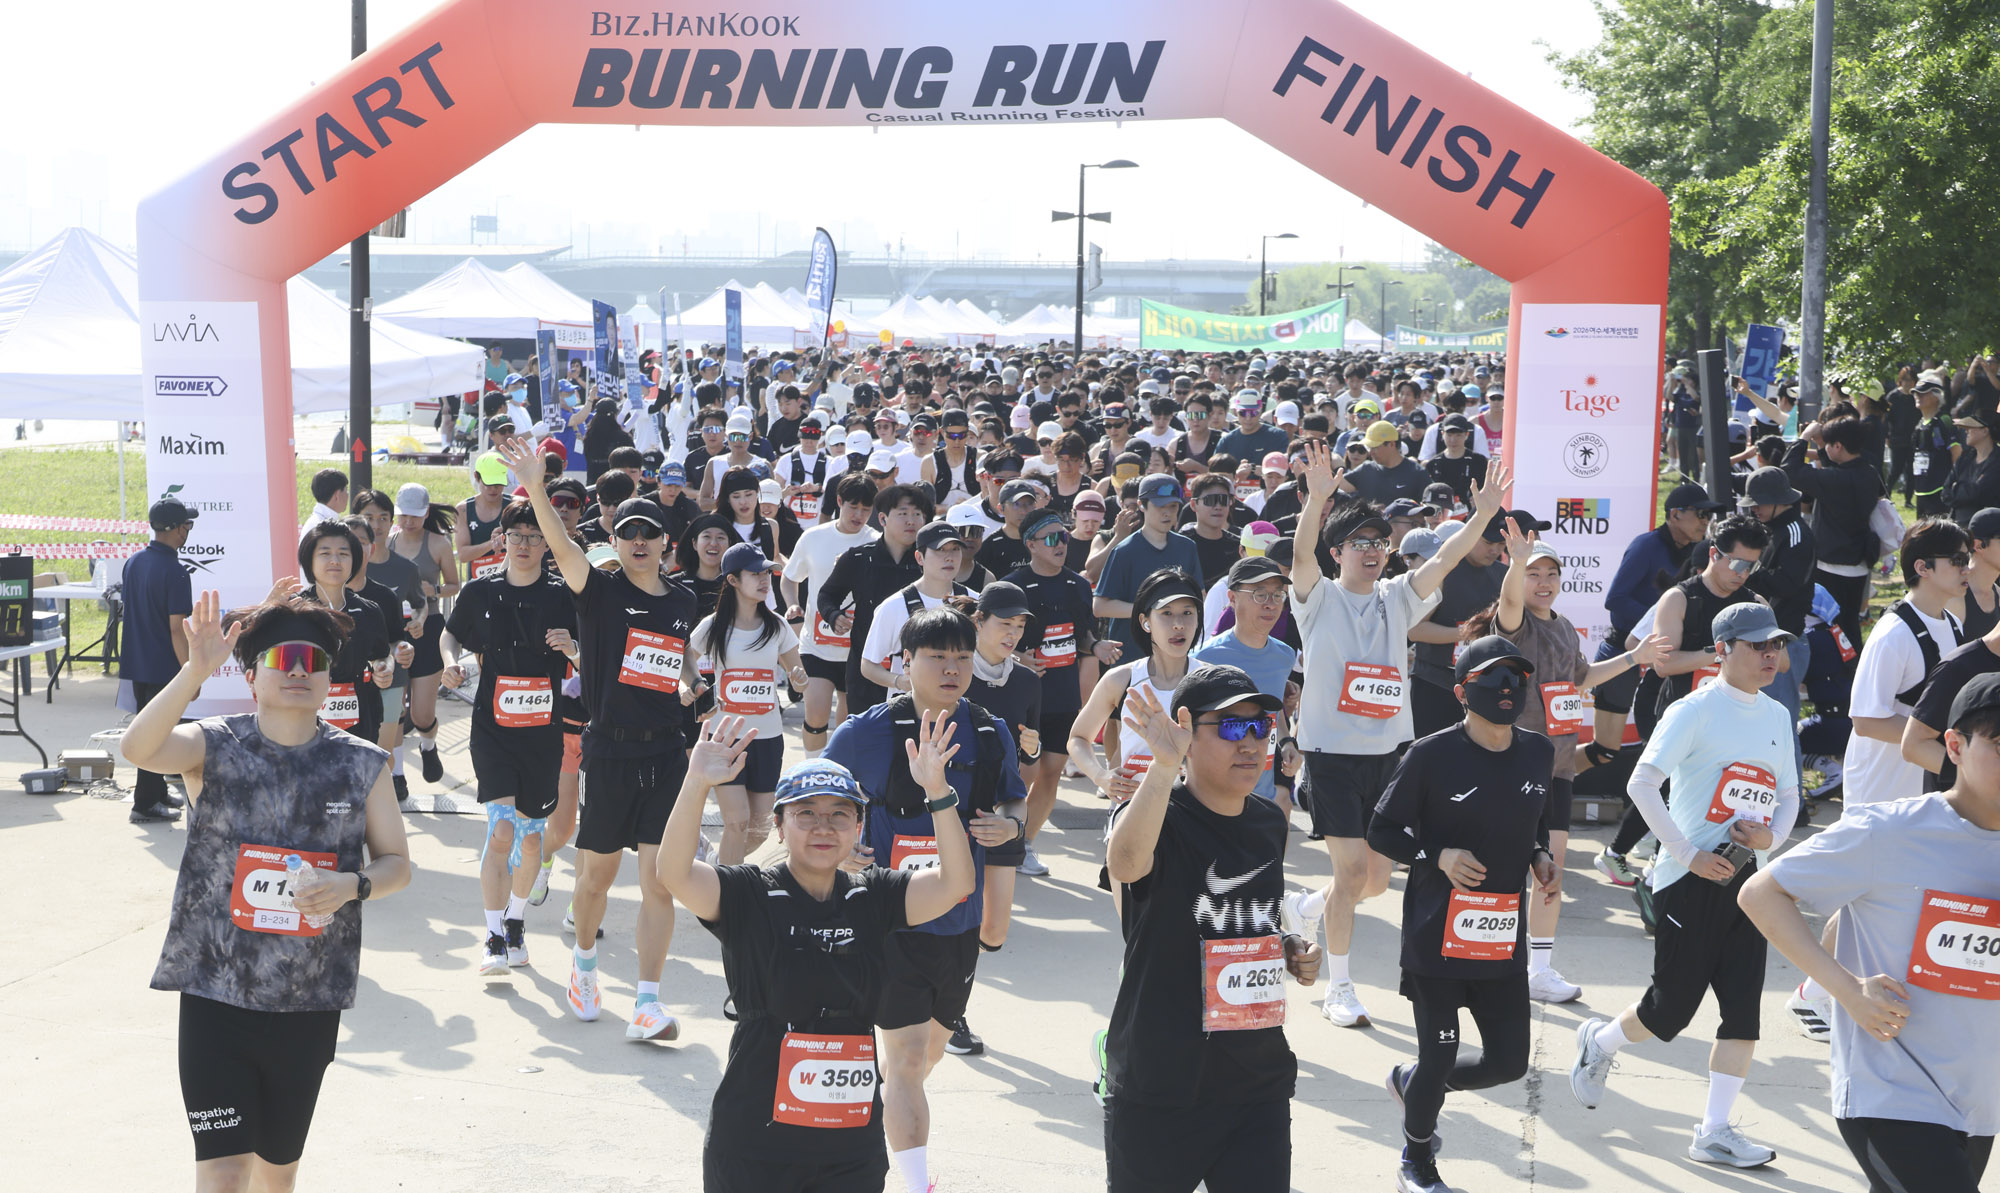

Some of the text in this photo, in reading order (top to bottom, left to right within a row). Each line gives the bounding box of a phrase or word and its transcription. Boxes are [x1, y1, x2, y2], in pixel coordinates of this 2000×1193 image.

[572, 40, 1166, 109] BURNING RUN
[865, 106, 1145, 123] Casual Running Festival
[221, 42, 456, 225] START
[1272, 36, 1555, 229] FINISH
[159, 380, 214, 396] FAVONEX
[1560, 389, 1621, 418] Tage
[159, 433, 225, 456] Maxim
[1570, 434, 1604, 449] SUNBODY
[1572, 464, 1601, 477] TANNING
[183, 500, 234, 512] EWTREE
[1557, 501, 1591, 519] BE-
[1555, 518, 1610, 535] KIND
[178, 543, 225, 556] eebok
[1560, 556, 1600, 568] TOUS
[1572, 568, 1587, 580] les
[1561, 581, 1603, 593] OURS
[636, 652, 646, 662] M
[649, 653, 682, 670] 1642
[742, 685, 772, 695] 4051
[1355, 683, 1402, 697] M 1663
[329, 700, 358, 711] 3866
[518, 695, 551, 705] 1464
[1563, 700, 1581, 711] 3907
[801, 774, 848, 790] HOKA
[1728, 788, 1774, 806] M 2167
[243, 849, 283, 861] BURNING
[253, 879, 269, 893] M
[1454, 894, 1484, 904] BURNING
[1928, 897, 1990, 915] BURNING RUN
[260, 914, 289, 925] B-234
[1461, 916, 1516, 931] M 2059
[1938, 933, 1956, 948] M
[1211, 944, 1246, 953] BURNING
[1228, 967, 1283, 988] M 2632
[787, 1039, 825, 1050] BURNING
[826, 1041, 844, 1050] RUN
[800, 1069, 874, 1087] W 3509
[188, 1107, 235, 1121] negative
[192, 1121, 212, 1133] split
